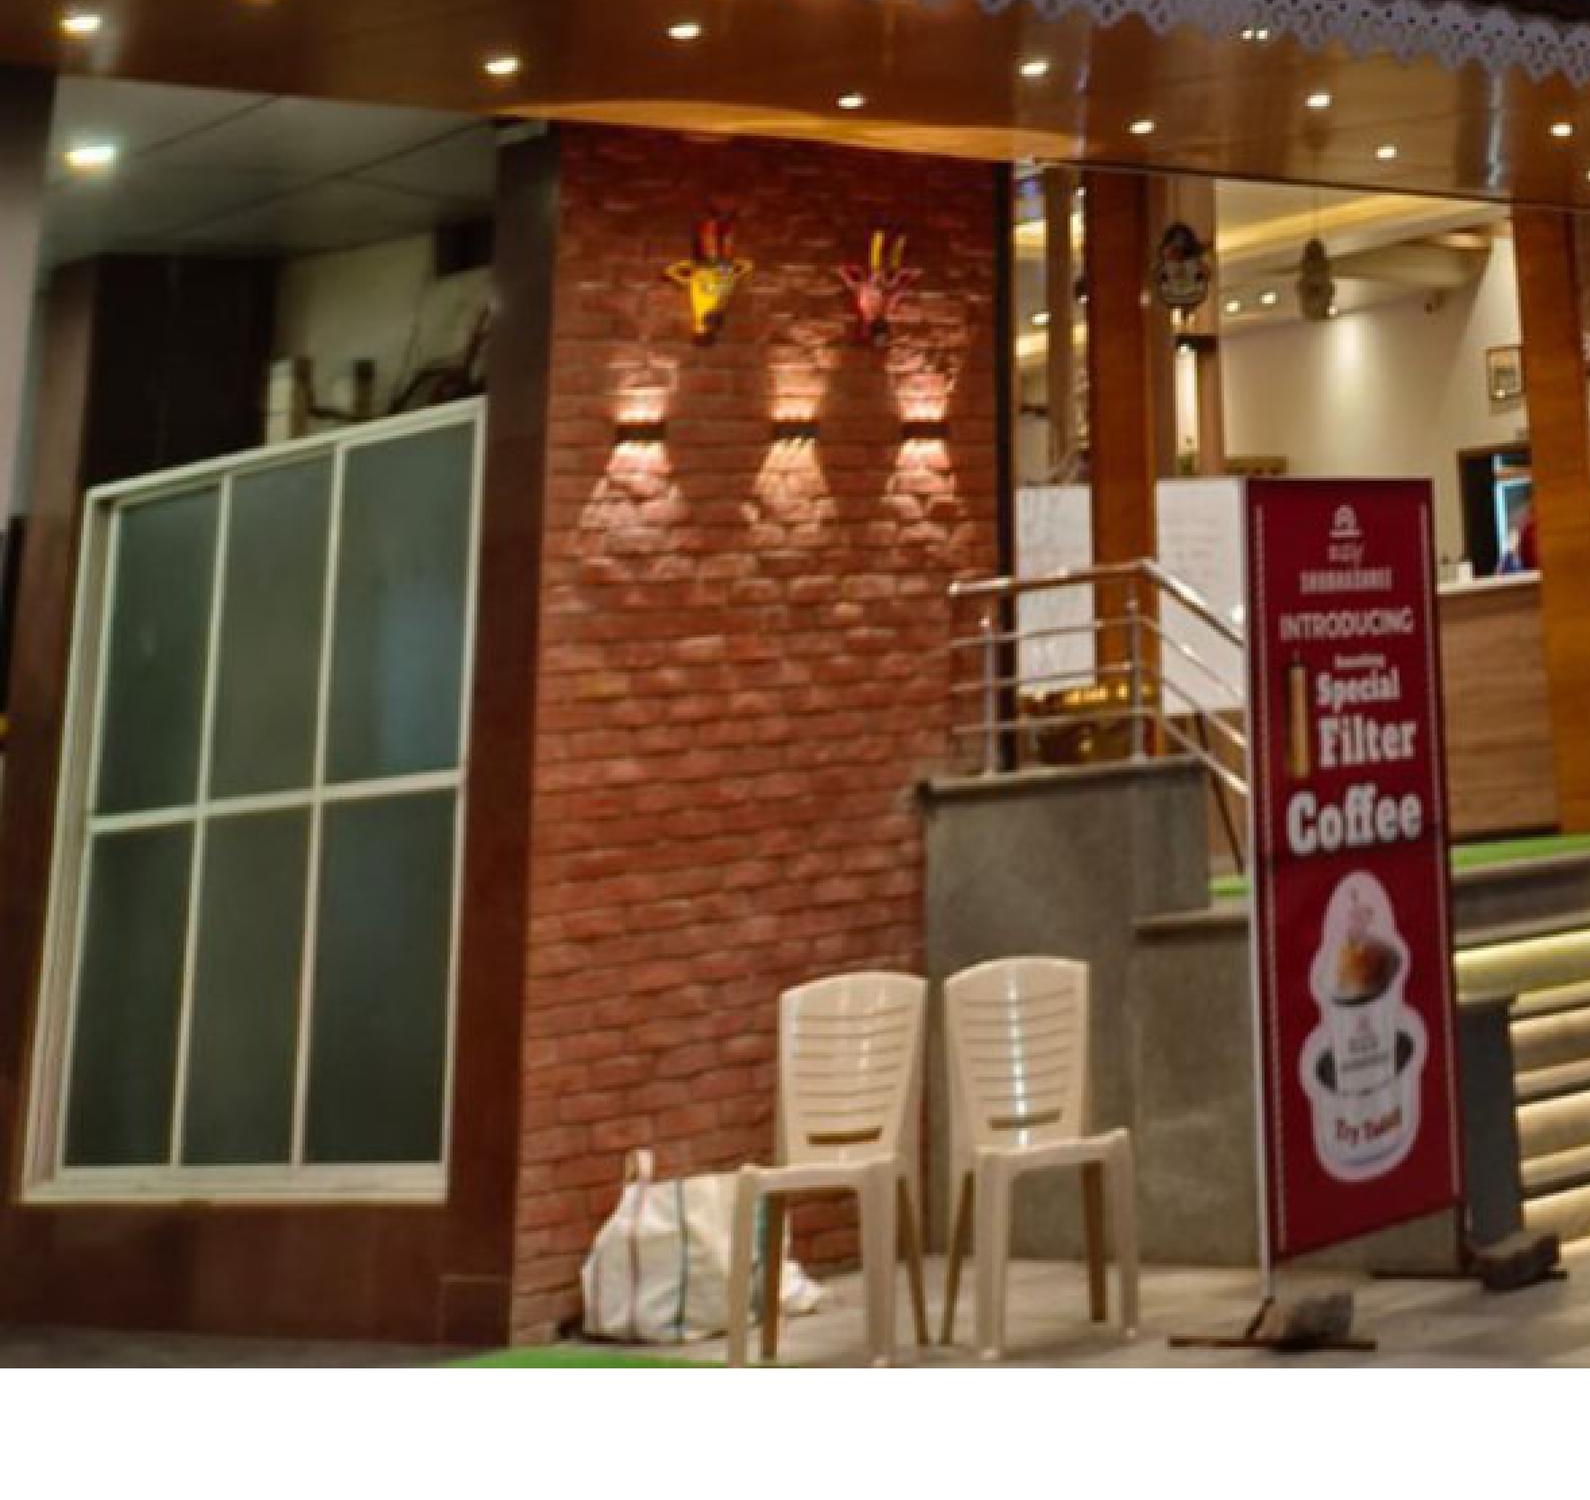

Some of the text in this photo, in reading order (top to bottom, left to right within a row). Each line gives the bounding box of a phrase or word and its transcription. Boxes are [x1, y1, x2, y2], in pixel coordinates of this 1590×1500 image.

[1281, 606, 1414, 641] INTRODUCING
[1316, 667, 1399, 713] Special
[1318, 714, 1417, 769] Filter
[1286, 783, 1423, 856] Coffee
